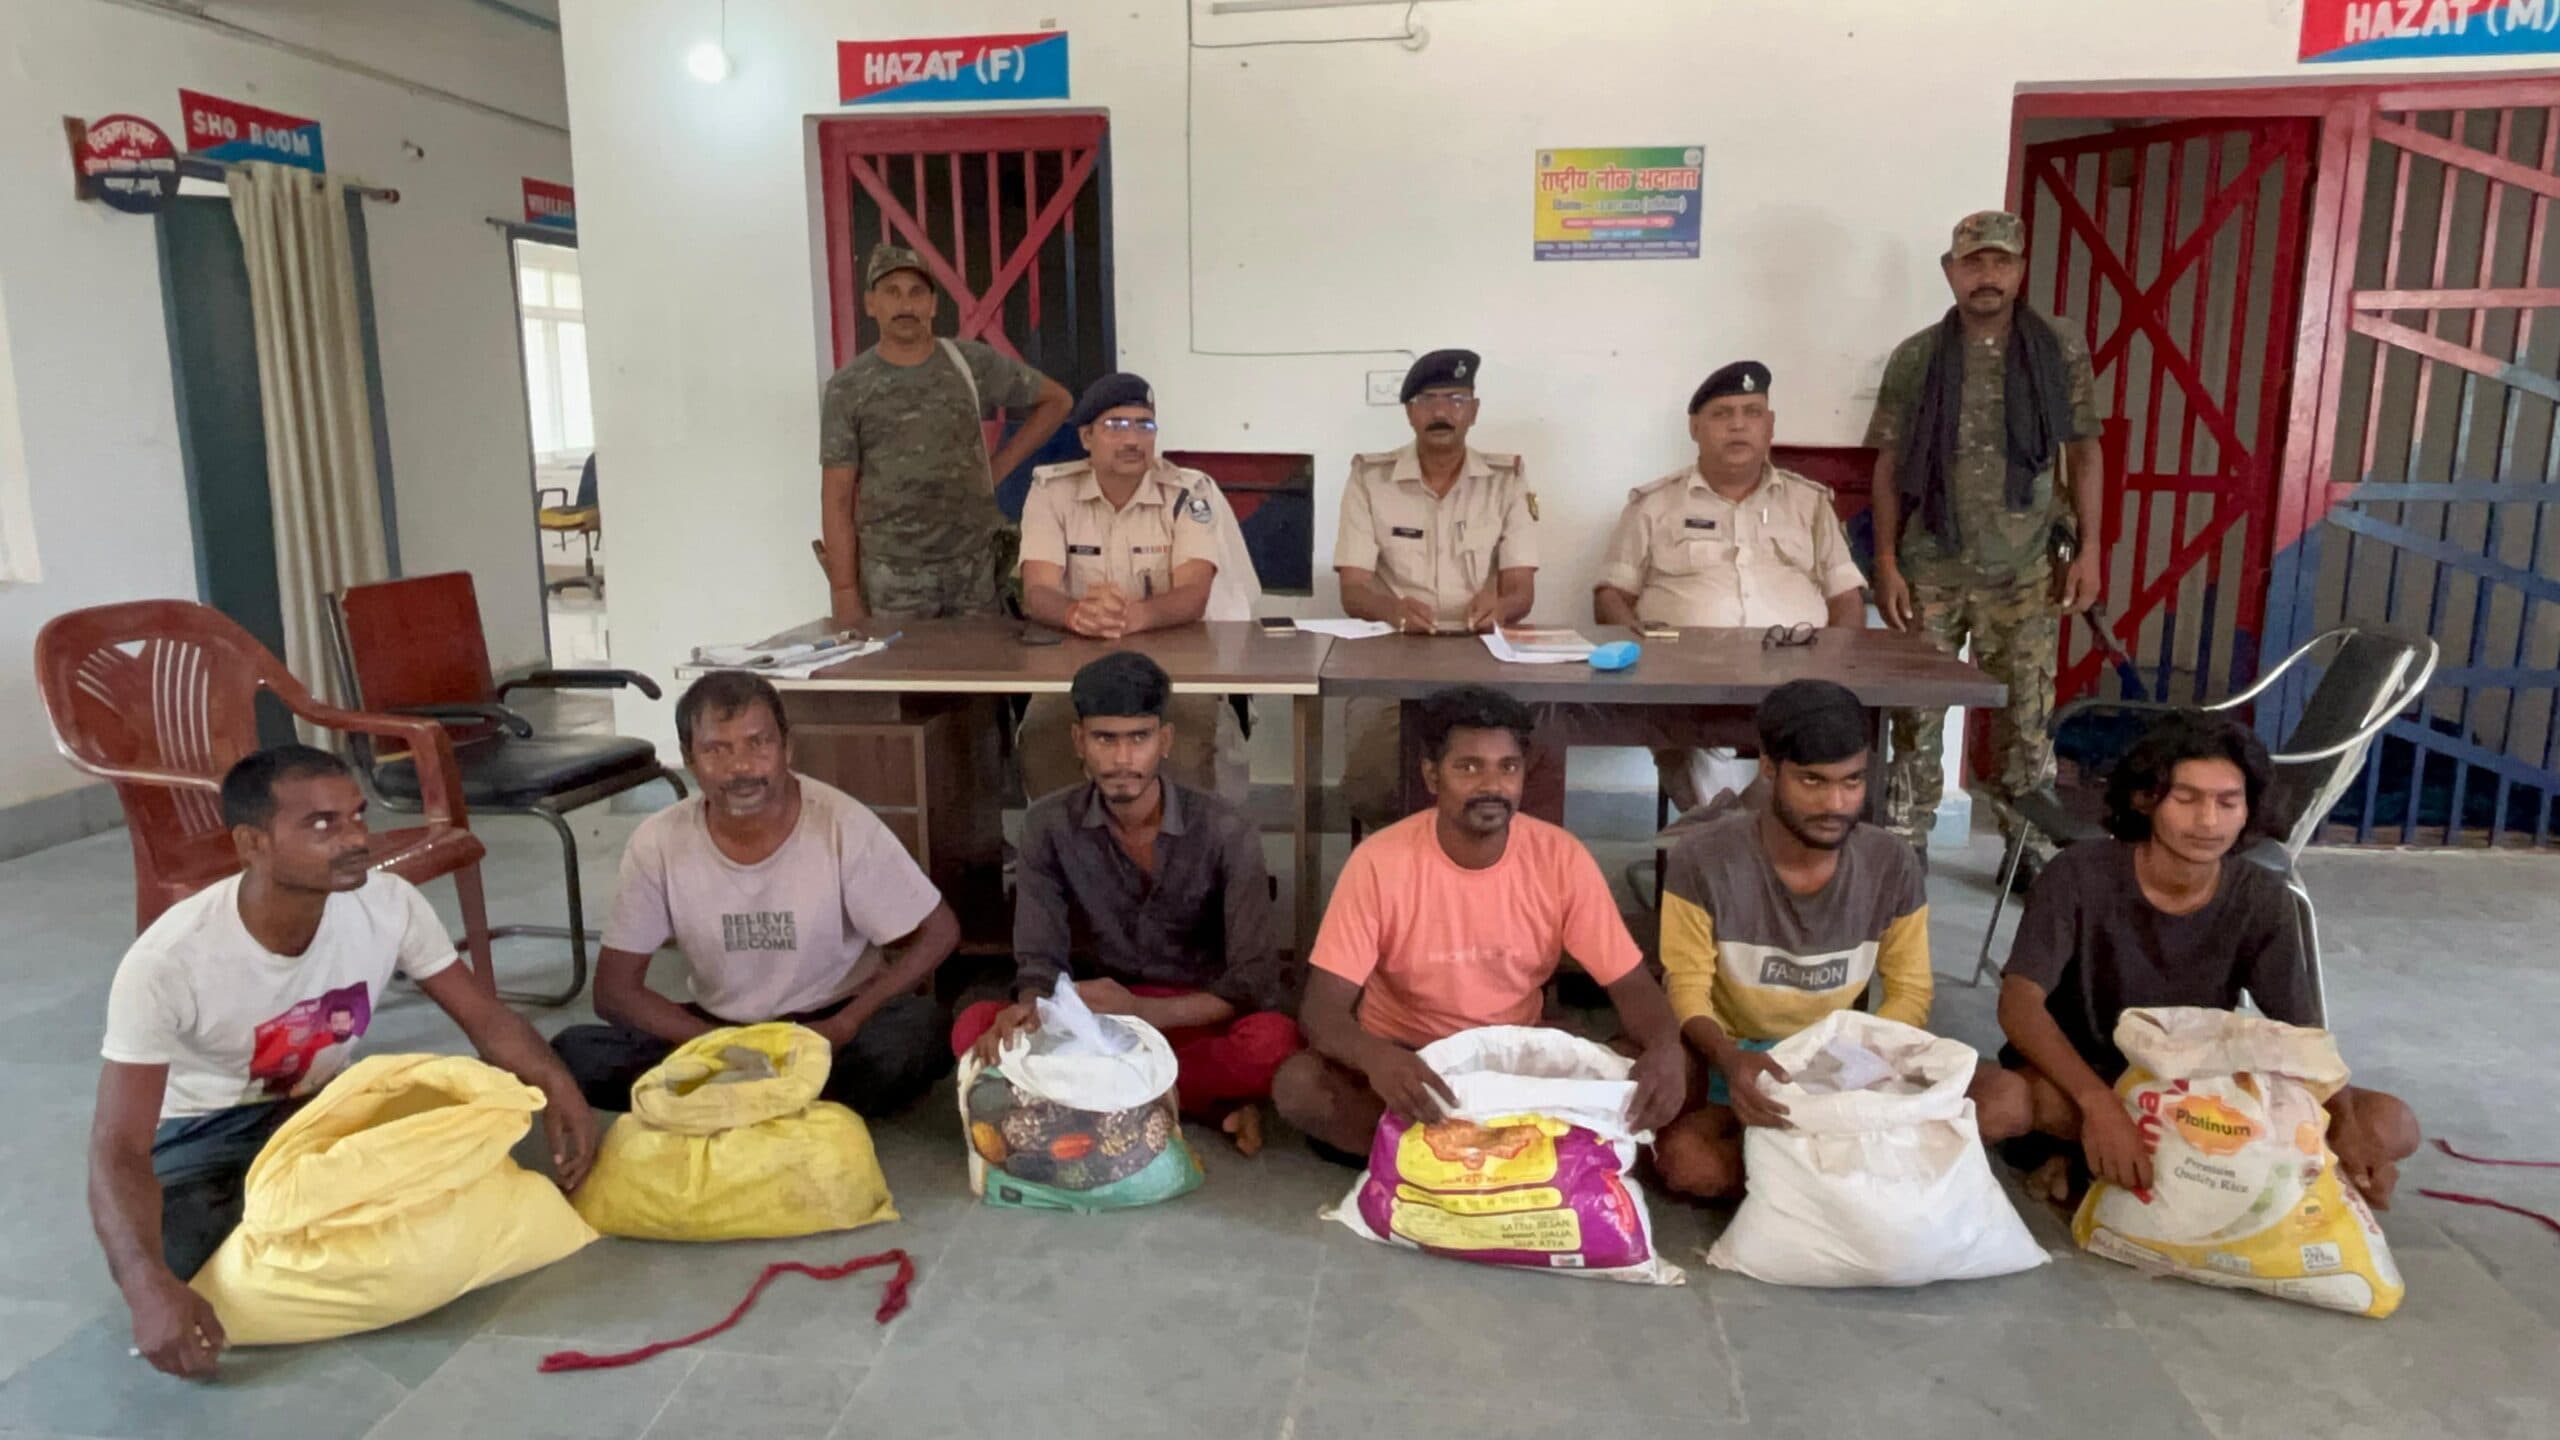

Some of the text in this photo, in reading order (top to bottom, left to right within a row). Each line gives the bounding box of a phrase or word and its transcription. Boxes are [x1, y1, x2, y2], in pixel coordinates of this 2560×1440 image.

[2344, 0, 2479, 43] HAZAT
[864, 45, 1026, 85] HAZAT (F)
[192, 110, 311, 156] SHO ROOM
[1595, 162, 1632, 191] लोक
[722, 911, 796, 926] BELIEVE
[1766, 961, 1844, 985] FAHION
[2176, 1108, 2251, 1137] Platinum
